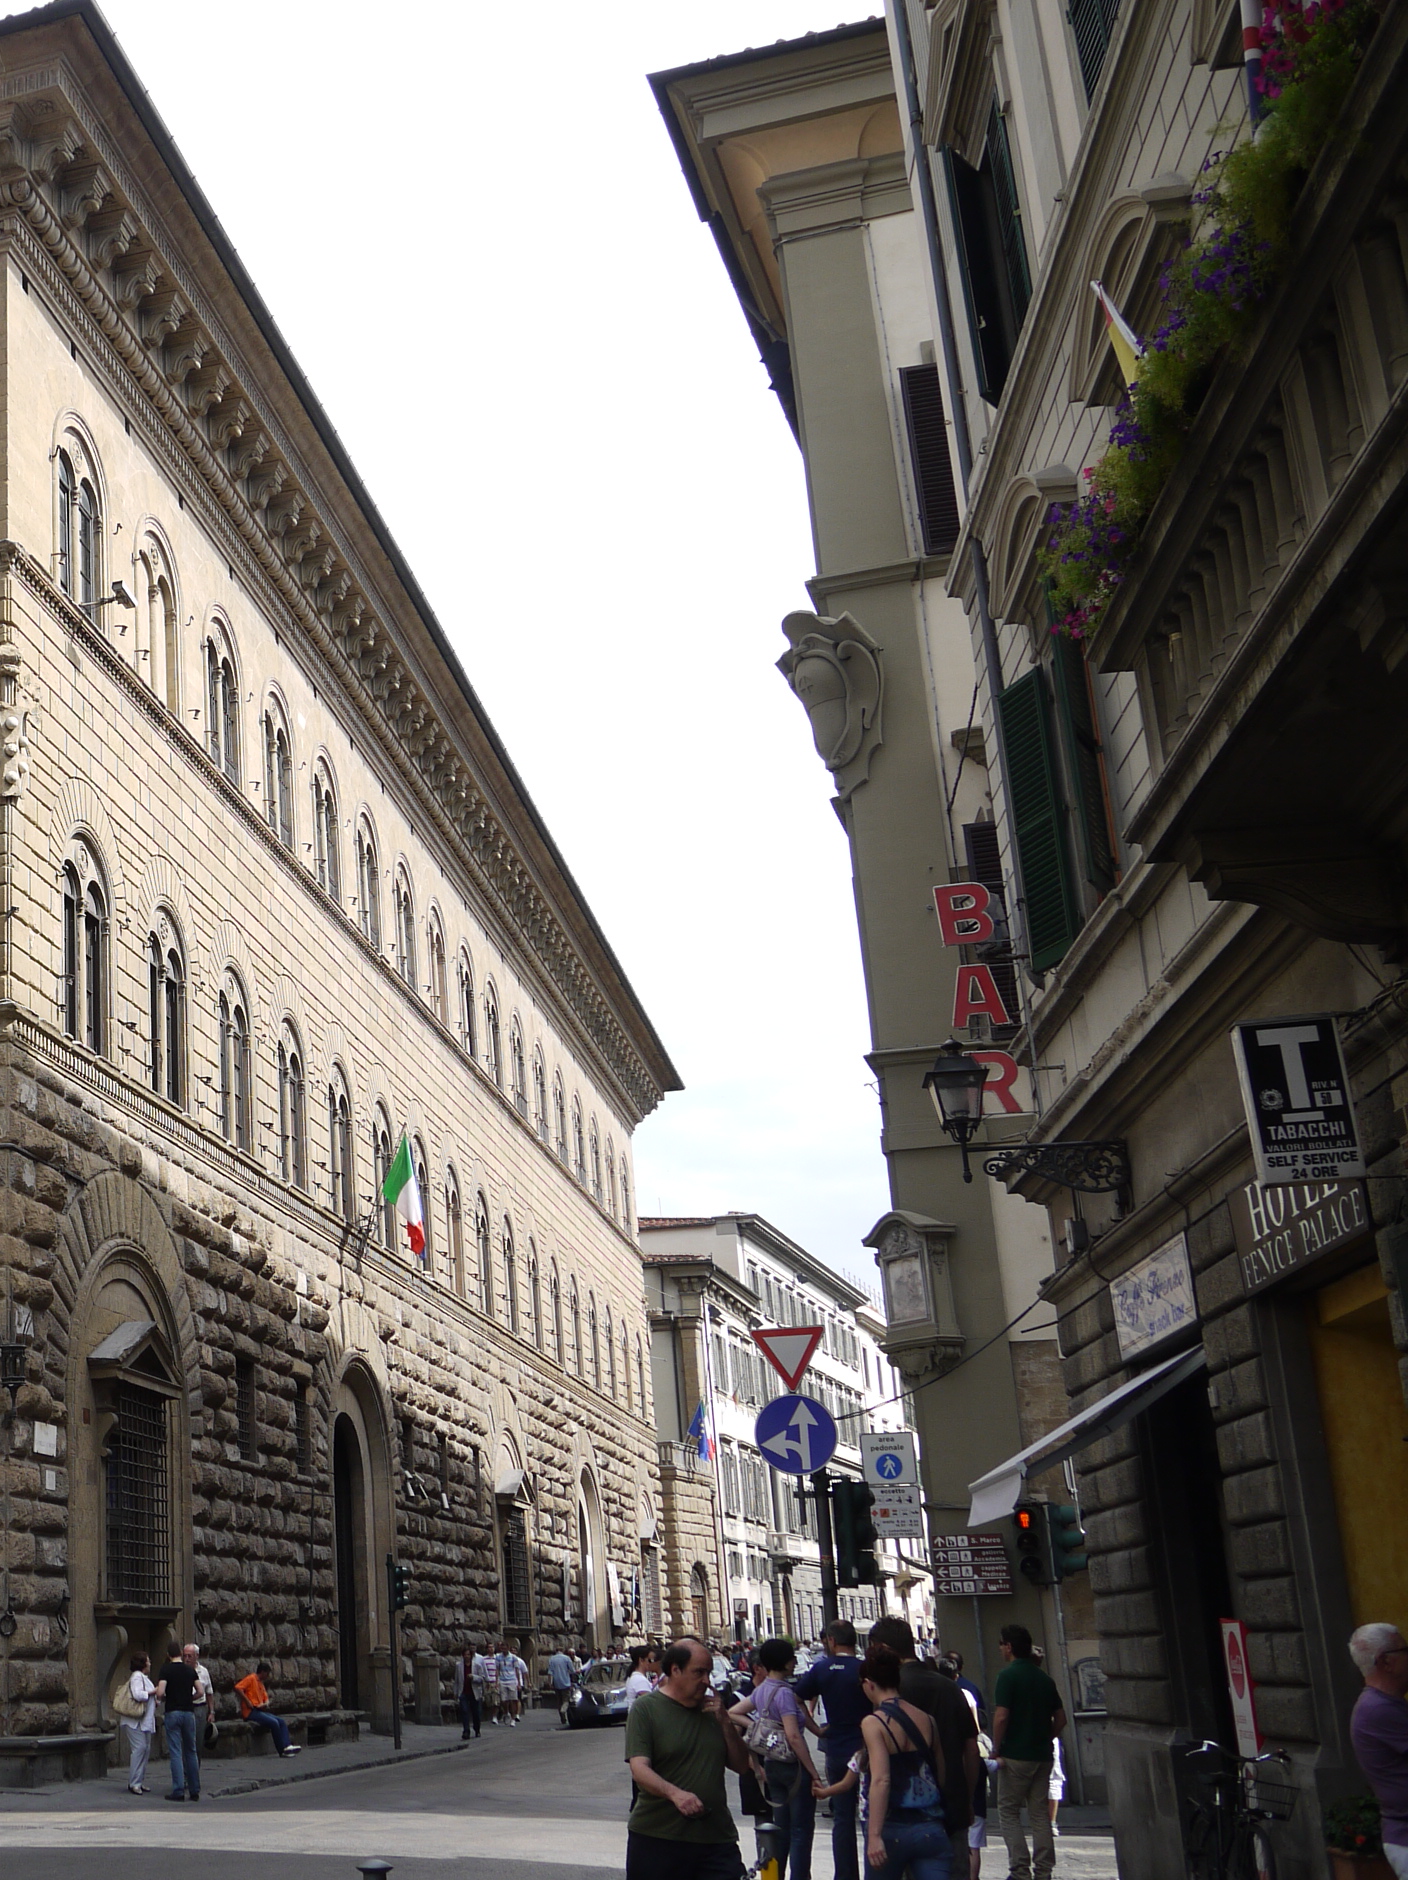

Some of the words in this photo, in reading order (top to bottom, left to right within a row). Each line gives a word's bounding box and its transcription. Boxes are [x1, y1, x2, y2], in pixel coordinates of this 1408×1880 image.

[933, 882, 1023, 1114] BAR
[1267, 1121, 1346, 1141] TABACCHI
[1266, 1142, 1305, 1153] VALORI
[1309, 1139, 1352, 1150] BOLLATI
[1267, 1154, 1299, 1168] SELF
[1302, 1150, 1359, 1166] SERVICE
[1292, 1168, 1309, 1180] 24
[1311, 1165, 1340, 1178] ORE
[1242, 1229, 1297, 1289] FENICE
[1298, 1187, 1364, 1256] PALACE
[870, 1444, 905, 1452] pedonale
[880, 1487, 906, 1495] eccetto
